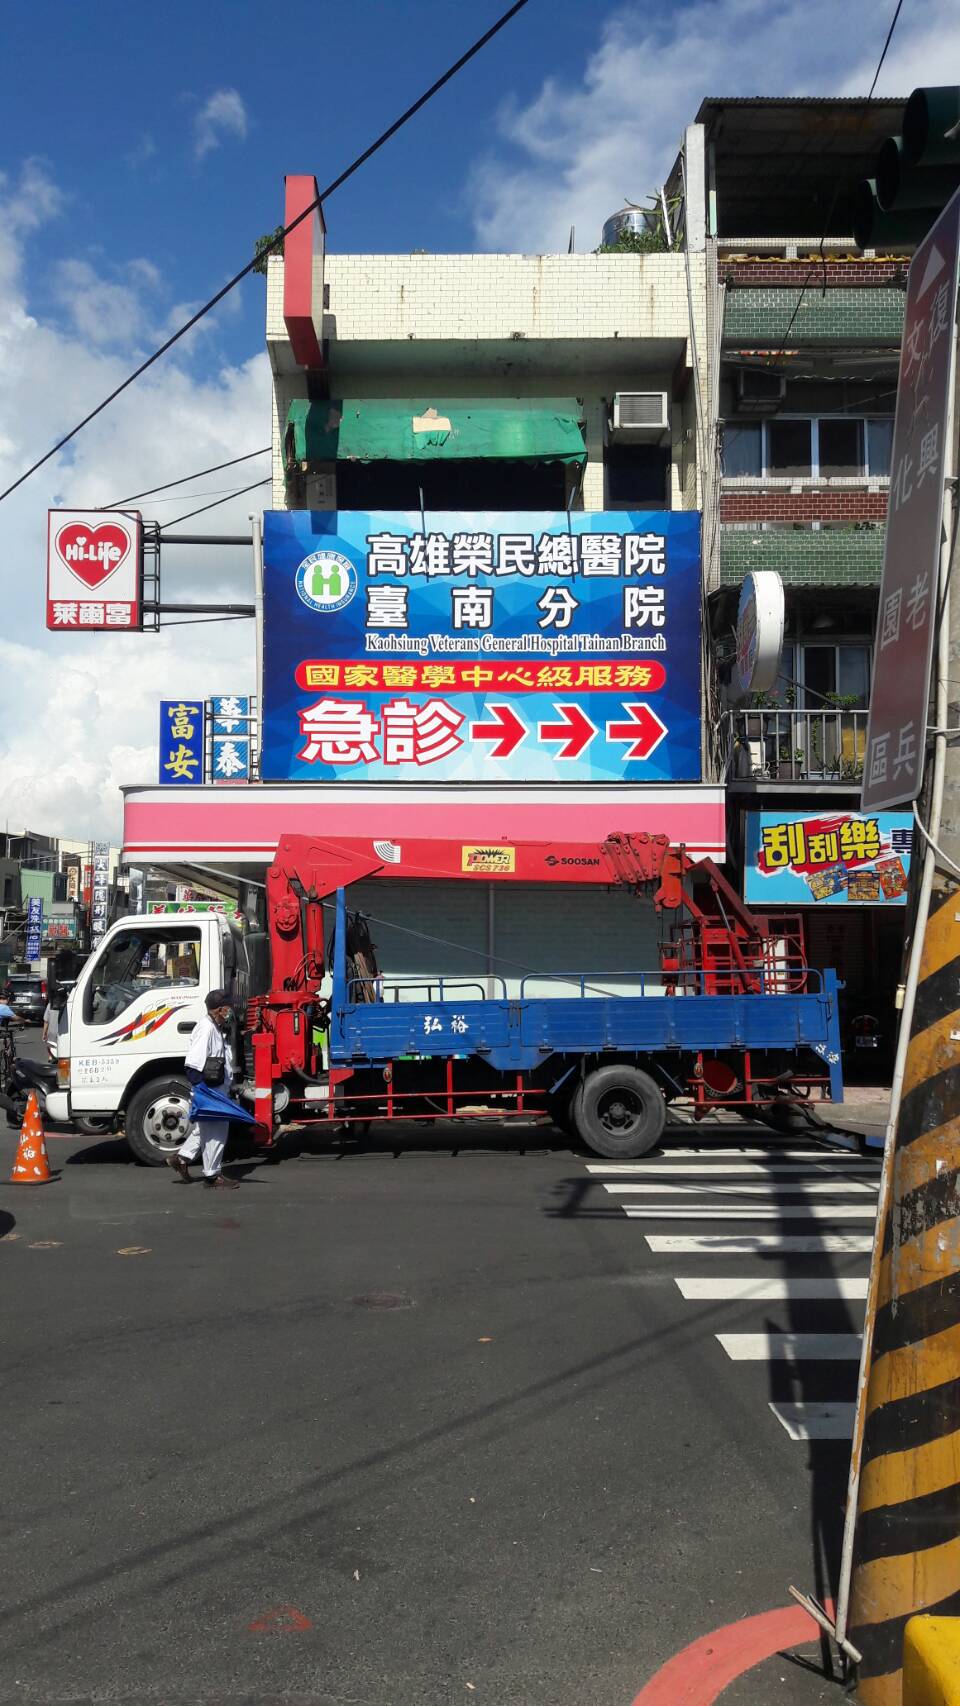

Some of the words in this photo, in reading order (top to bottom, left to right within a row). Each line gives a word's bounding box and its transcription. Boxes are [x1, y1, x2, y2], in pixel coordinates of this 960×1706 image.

[65, 537, 122, 570] Hi-Life
[366, 534, 666, 577] 高雄榮民總醫院
[53, 603, 131, 625] 萊爾富
[366, 585, 666, 629] 臺南分院
[366, 634, 428, 656] Kaohsiung
[429, 634, 479, 652] Veterans
[481, 634, 528, 652] General
[530, 634, 579, 656] Hospital
[580, 634, 620, 652] Tainan
[621, 634, 666, 652] Branch
[304, 664, 652, 688] 國家醫學中心級服務
[164, 703, 199, 780] 富安
[297, 698, 466, 766] 急診
[762, 818, 881, 867] 刮刮樂
[561, 857, 600, 866] SOOSAN
[423, 1014, 470, 1035] 弘裕
